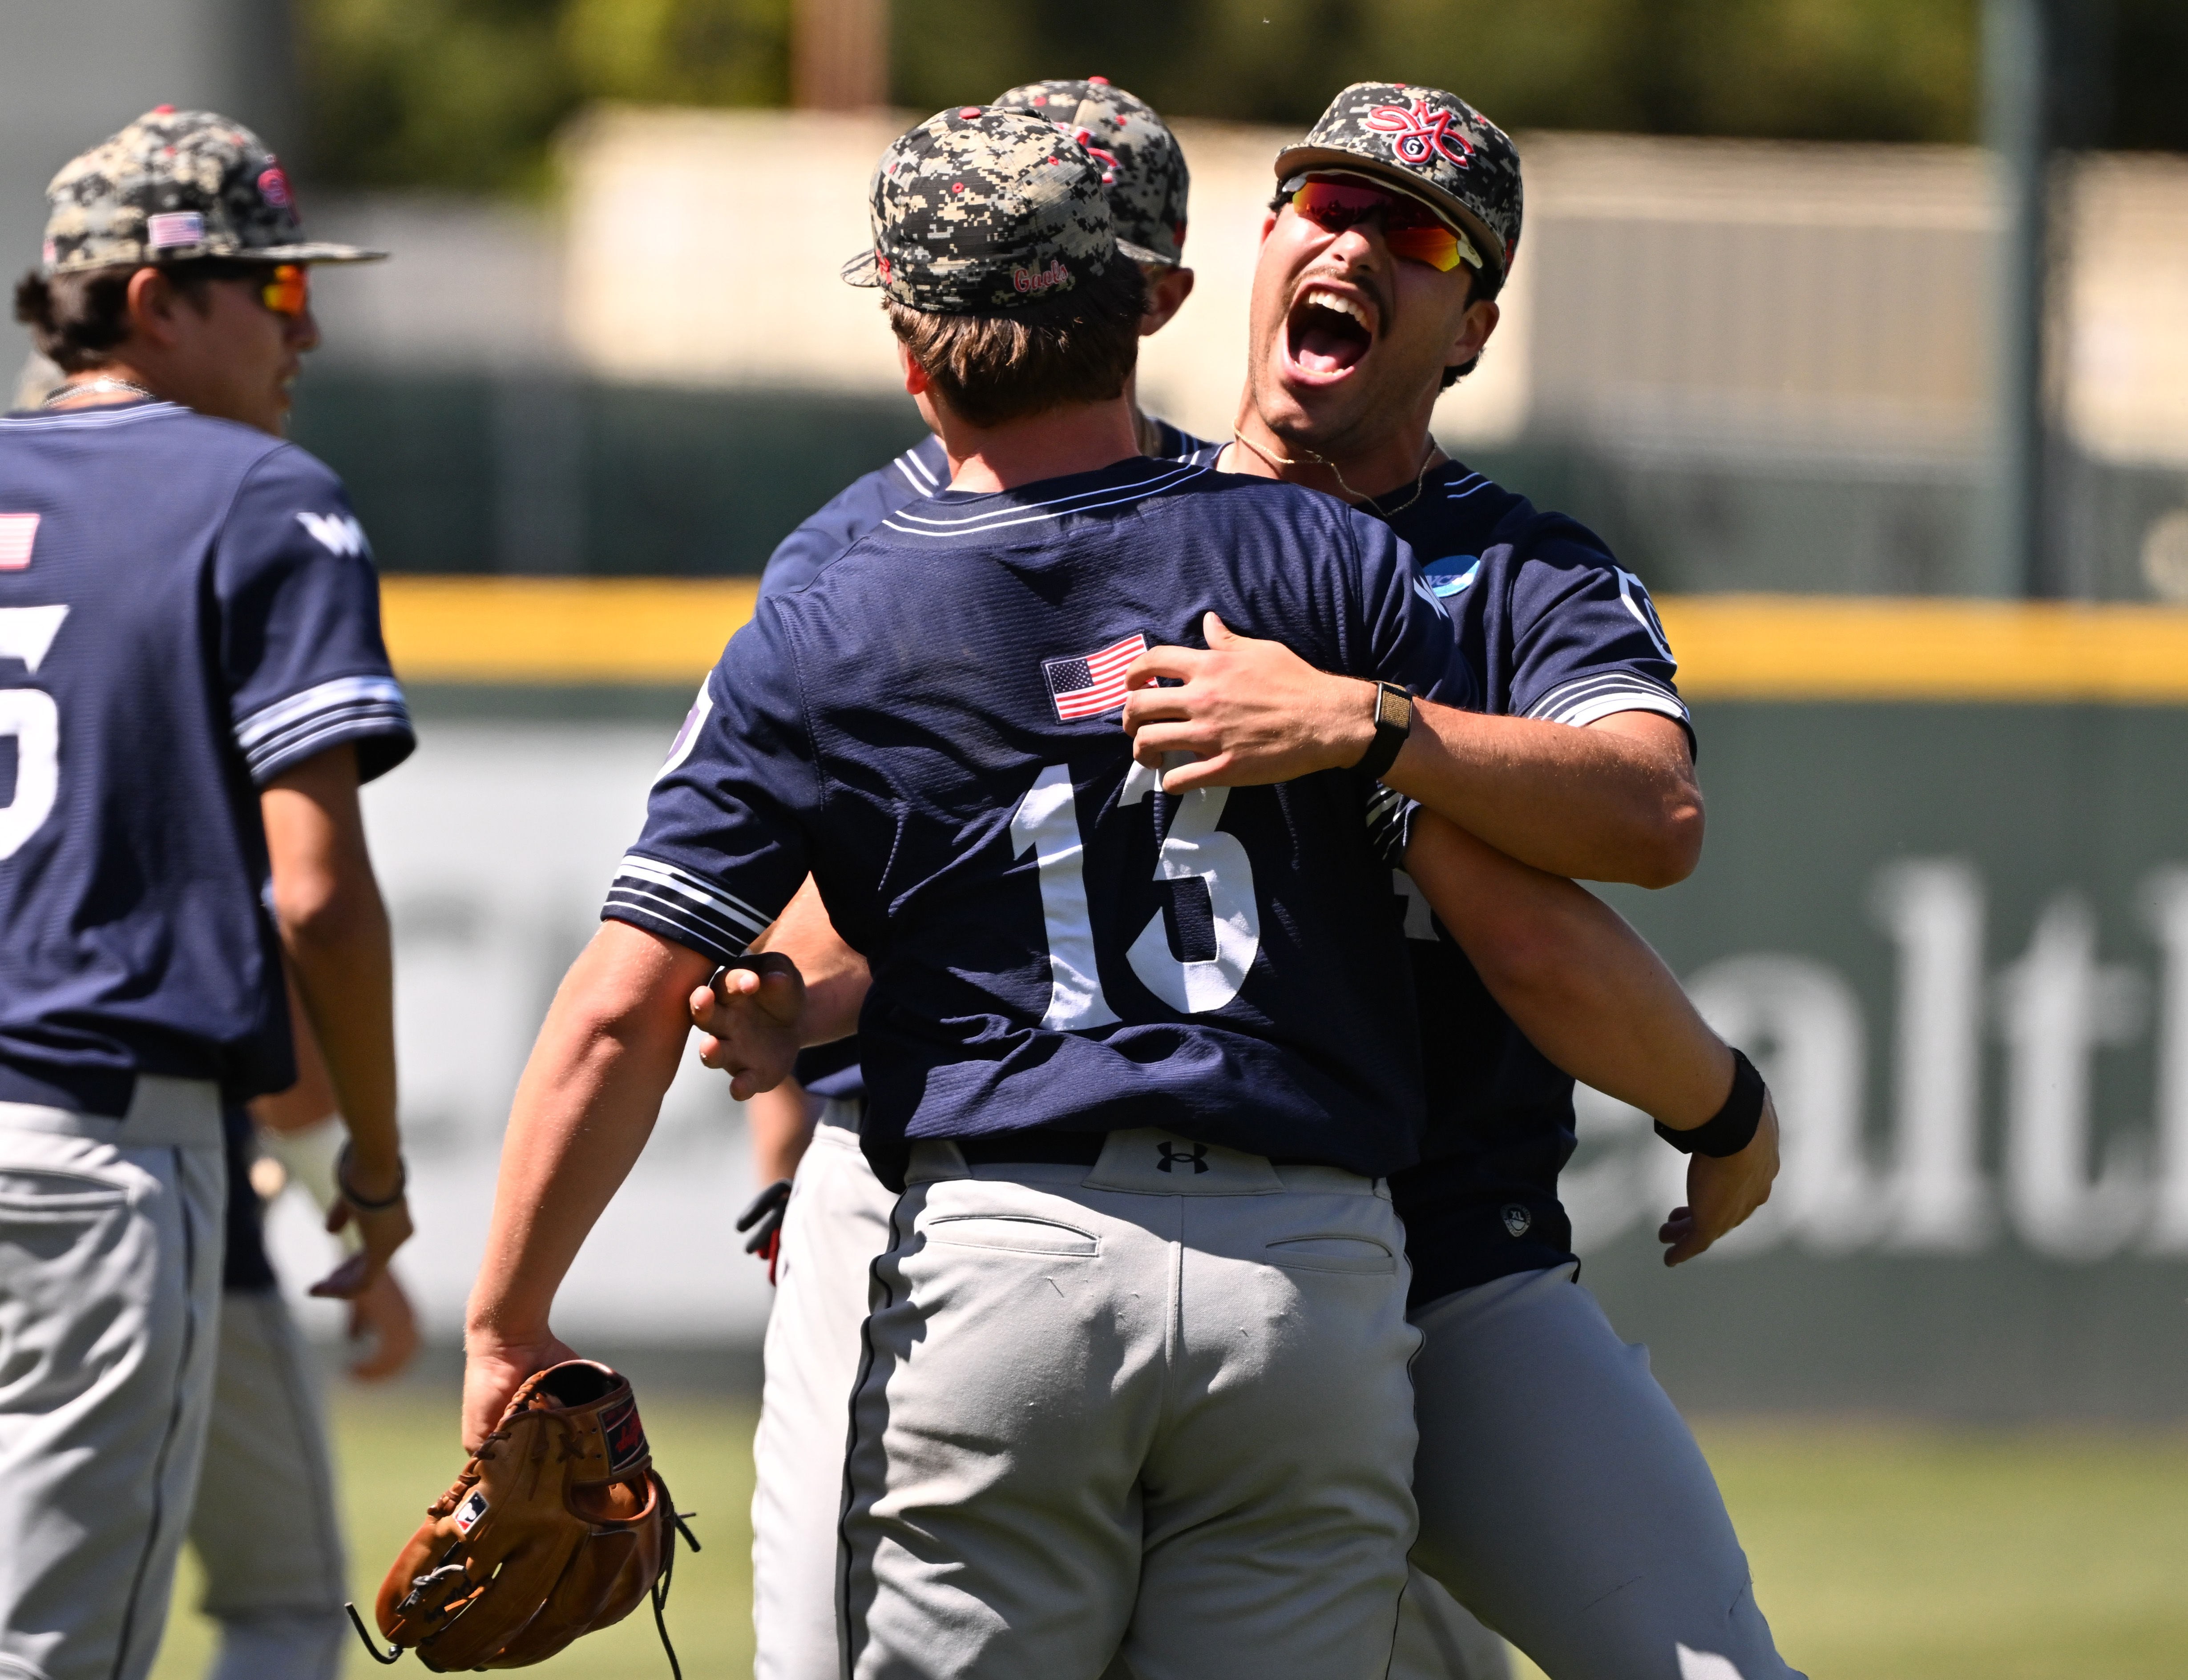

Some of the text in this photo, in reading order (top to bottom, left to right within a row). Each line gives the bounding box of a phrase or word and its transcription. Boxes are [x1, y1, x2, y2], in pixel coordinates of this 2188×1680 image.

[1013, 259, 1068, 293] Gaels
[1009, 750, 1260, 1031] 13
[1559, 854, 2188, 1263] alt
